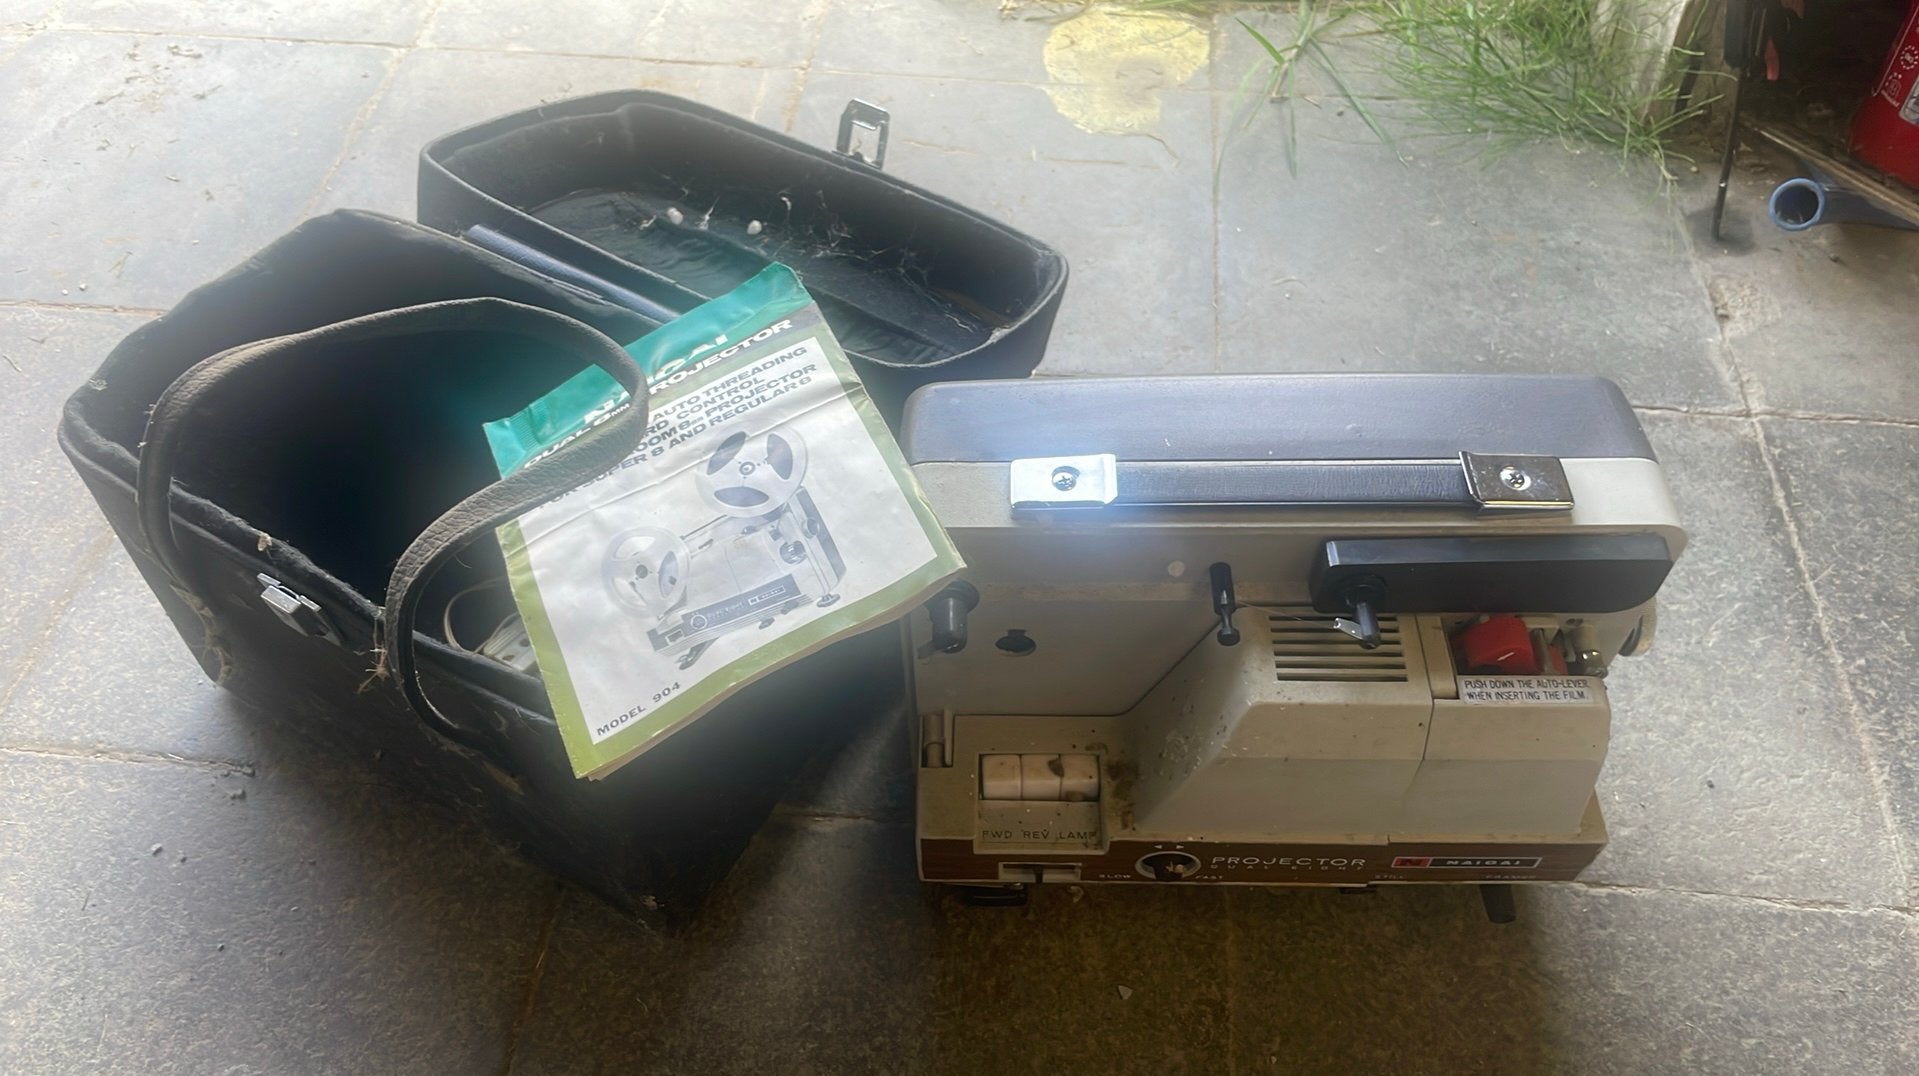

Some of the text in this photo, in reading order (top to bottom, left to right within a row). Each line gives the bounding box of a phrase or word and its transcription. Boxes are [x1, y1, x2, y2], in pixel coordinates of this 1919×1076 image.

[648, 318, 793, 396] ROJECTOR
[634, 426, 678, 453] OOM
[704, 363, 818, 419] PROJECTOR
[652, 346, 808, 422] AUTO THREADING
[676, 372, 766, 420] CONTROL
[651, 446, 665, 457] 8
[668, 423, 707, 450] AND
[708, 380, 799, 427] REGULAR
[799, 375, 813, 386] 8
[596, 681, 681, 736] MODEL 904
[1464, 679, 1487, 689] PUSH
[1490, 679, 1515, 689] DOWN
[1517, 679, 1534, 689] THE
[1466, 690, 1493, 701] WHEN
[1495, 690, 1541, 701] INSERTING
[1543, 690, 1560, 700] THE
[982, 830, 1098, 840] FWD REV LAMP
[1212, 856, 1366, 866] PROJECTOR
